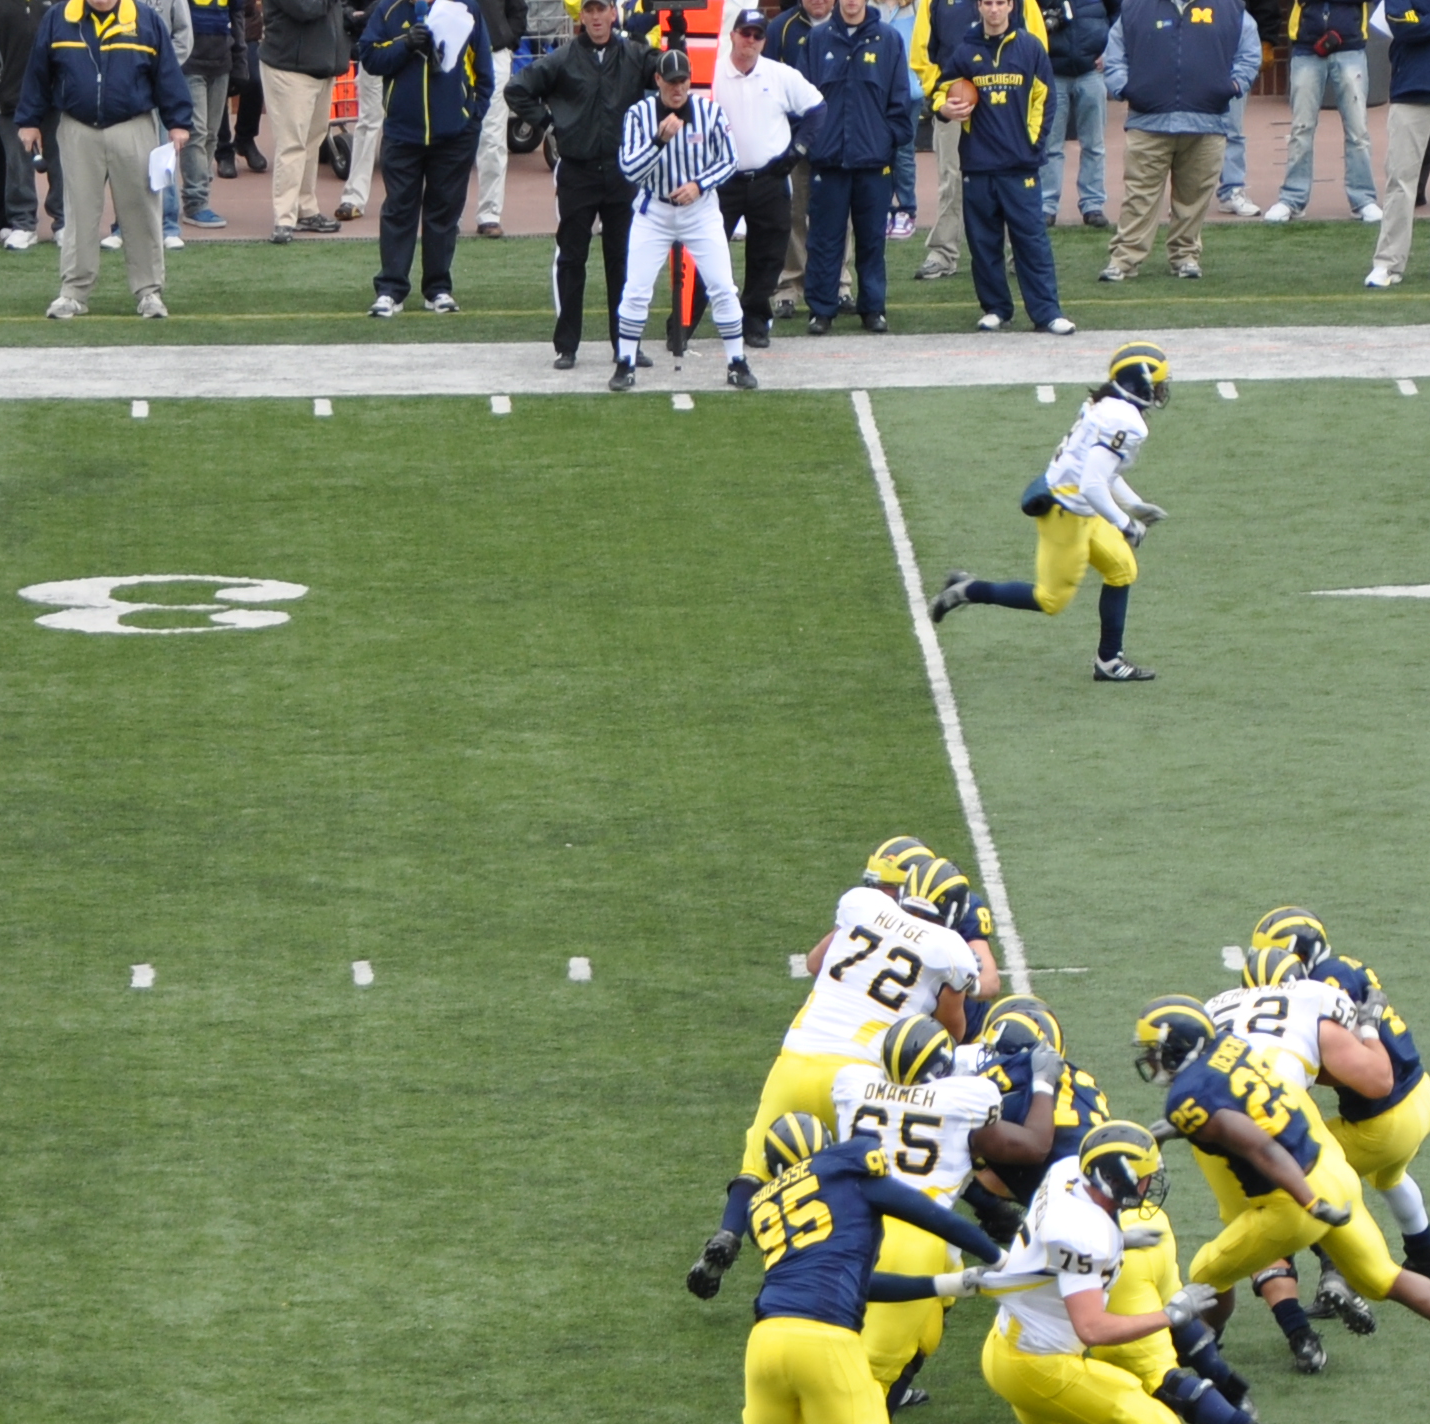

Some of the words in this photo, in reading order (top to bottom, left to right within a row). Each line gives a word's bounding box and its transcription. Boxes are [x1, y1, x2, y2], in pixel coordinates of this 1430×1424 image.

[1190, 7, 1212, 23] M
[991, 91, 1007, 105] M
[873, 910, 930, 945] HUYGE
[829, 924, 923, 1013] 72
[864, 1081, 937, 1108] OMAMEH
[1169, 1097, 1210, 1135] 25
[850, 1103, 945, 1177] 65
[749, 1158, 813, 1212] SAGESSE
[751, 1174, 834, 1272] 95
[1059, 1248, 1094, 1275] 75
